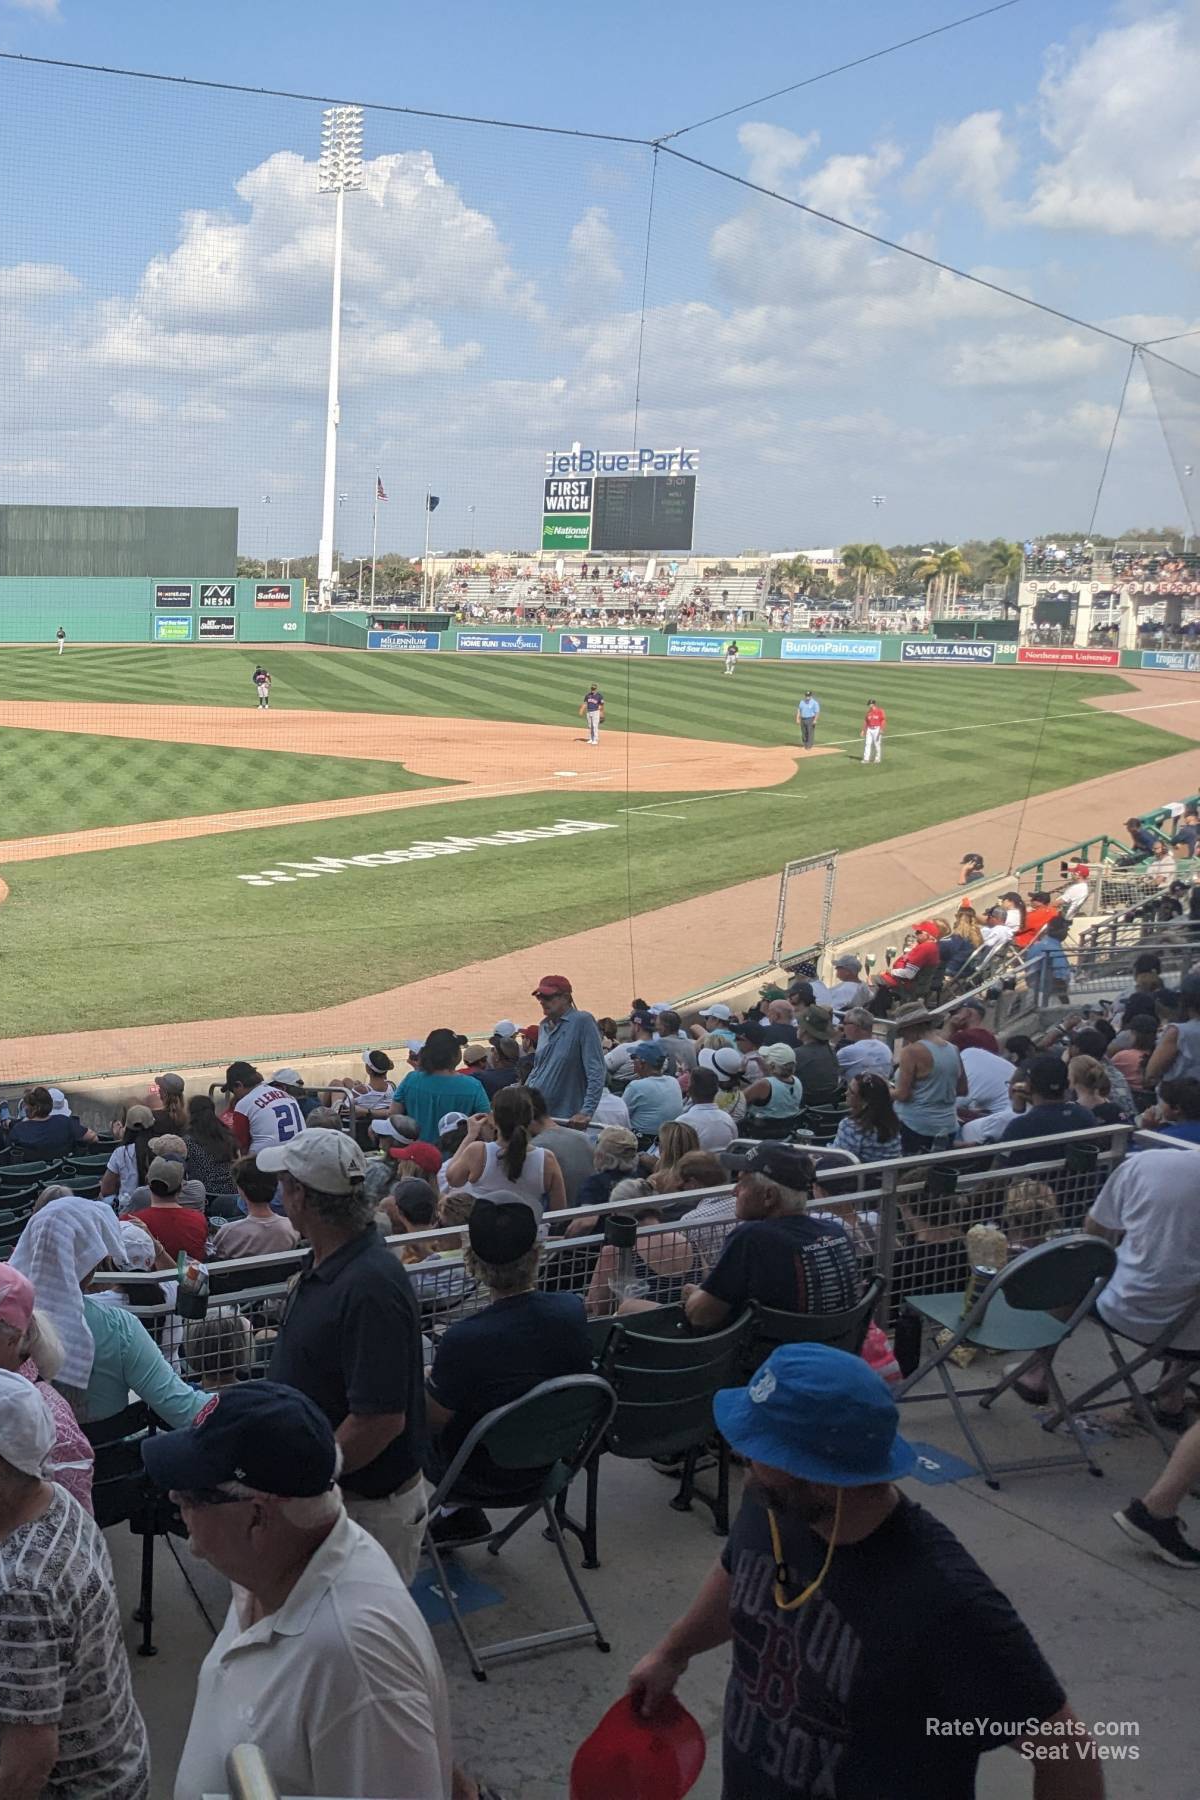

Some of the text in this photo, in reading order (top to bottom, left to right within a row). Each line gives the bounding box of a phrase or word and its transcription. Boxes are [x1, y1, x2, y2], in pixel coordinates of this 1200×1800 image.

[550, 448, 693, 477] jetBlue Park
[550, 481, 588, 496] FIRST
[546, 496, 590, 510] WATCH
[554, 526, 590, 535] National
[1049, 582, 1056, 592] 4
[257, 592, 289, 600] Safelite
[588, 636, 644, 644] BEST
[786, 640, 876, 653] BunionPain.com
[905, 645, 991, 657] SAMUEL ADAMS
[997, 645, 1016, 653] 380
[1025, 652, 1073, 660] Northeasern
[276, 818, 620, 874] MassMutual
[272, 1102, 302, 1142] 21
[729, 1549, 862, 1703] BOON
